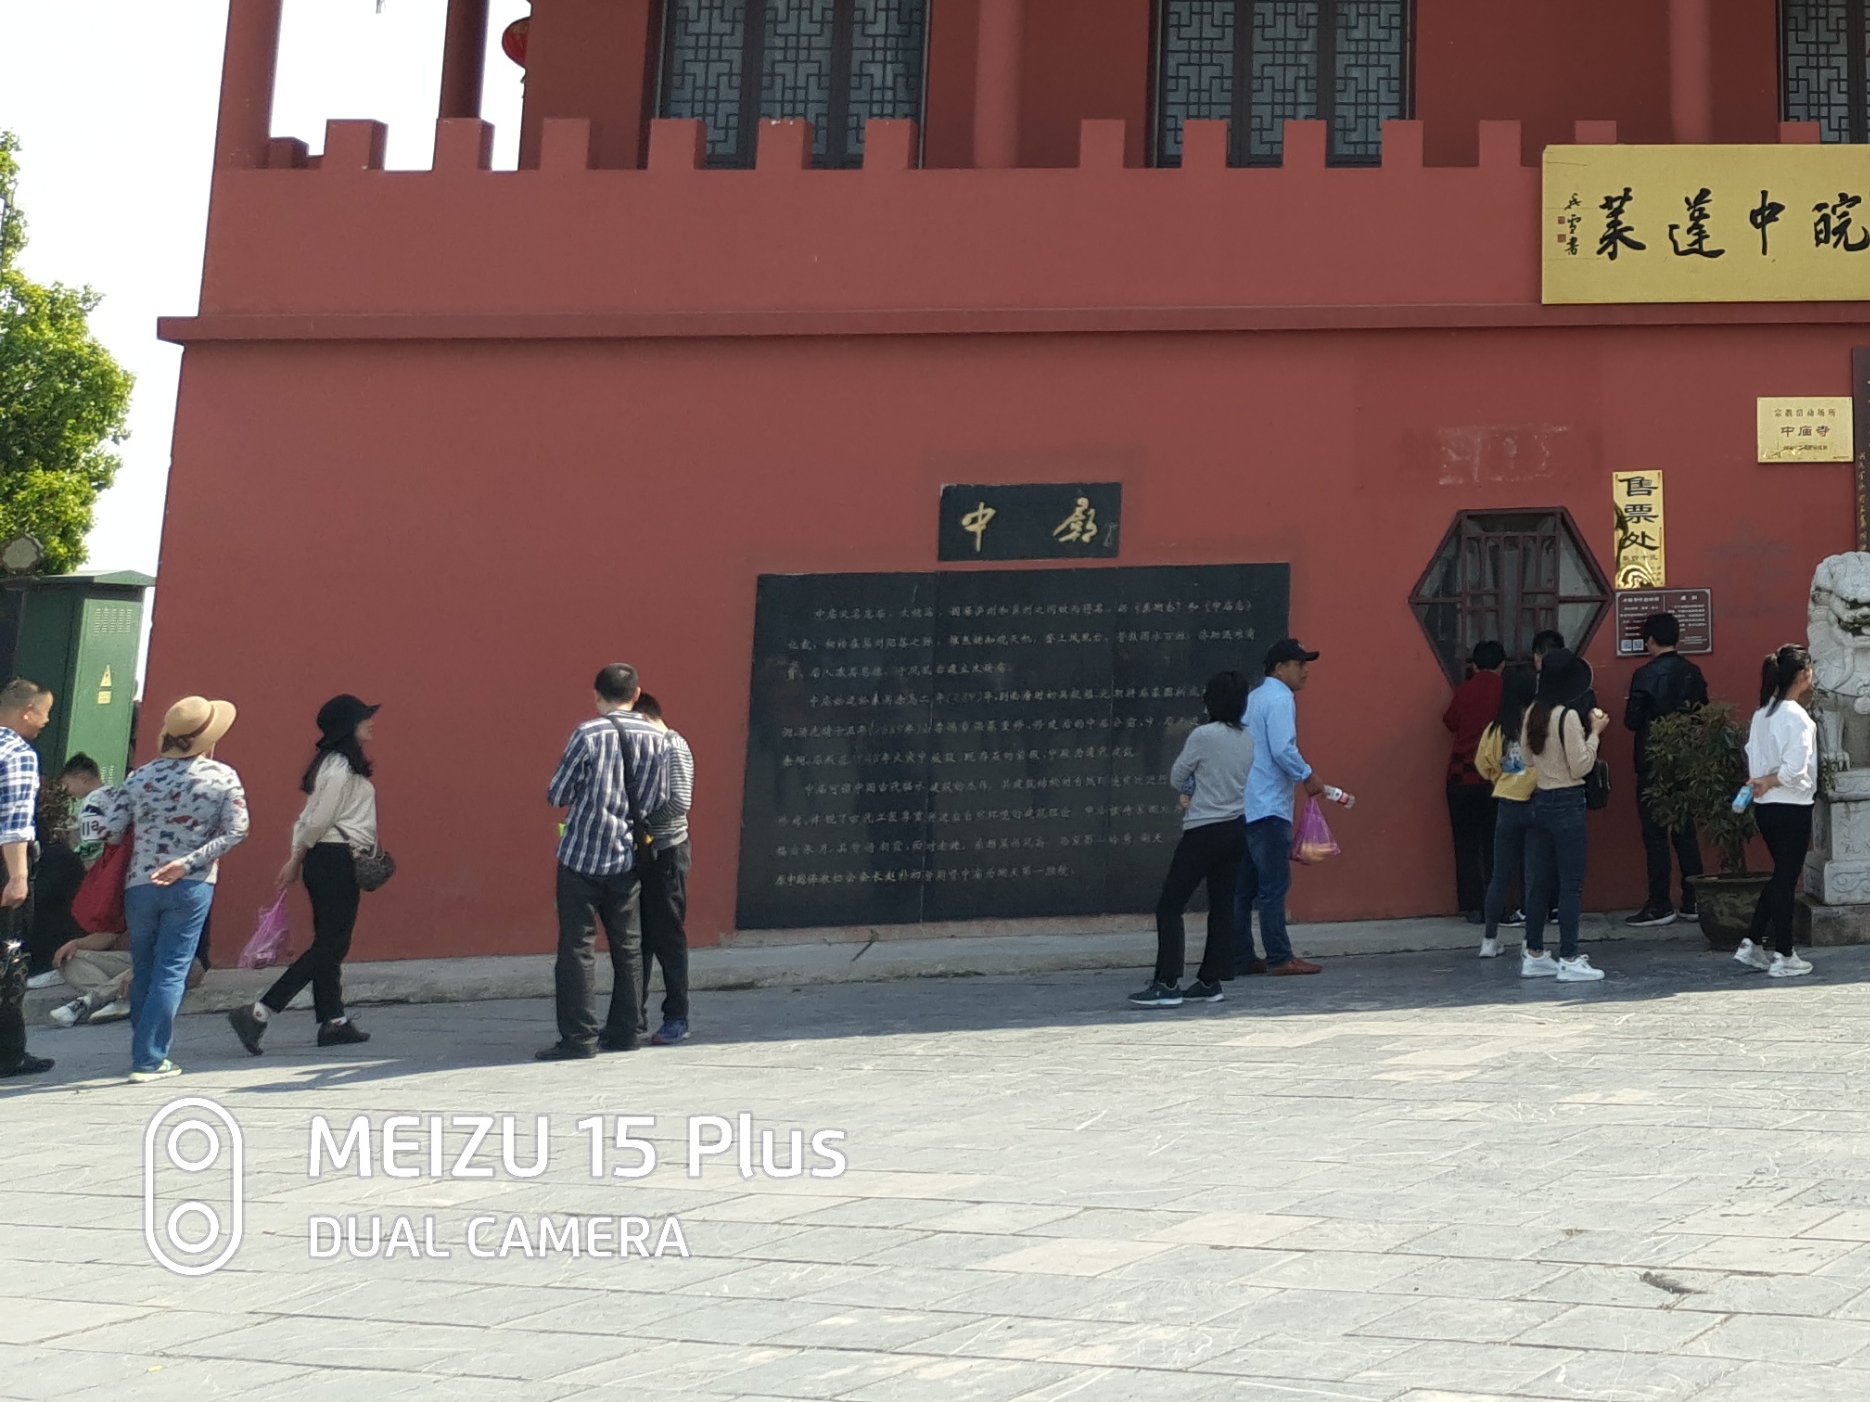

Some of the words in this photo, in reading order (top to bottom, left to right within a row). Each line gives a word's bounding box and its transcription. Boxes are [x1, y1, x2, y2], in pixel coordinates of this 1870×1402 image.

[1780, 425, 1832, 438] 中庙寺
[1619, 476, 1660, 551] 售票处
